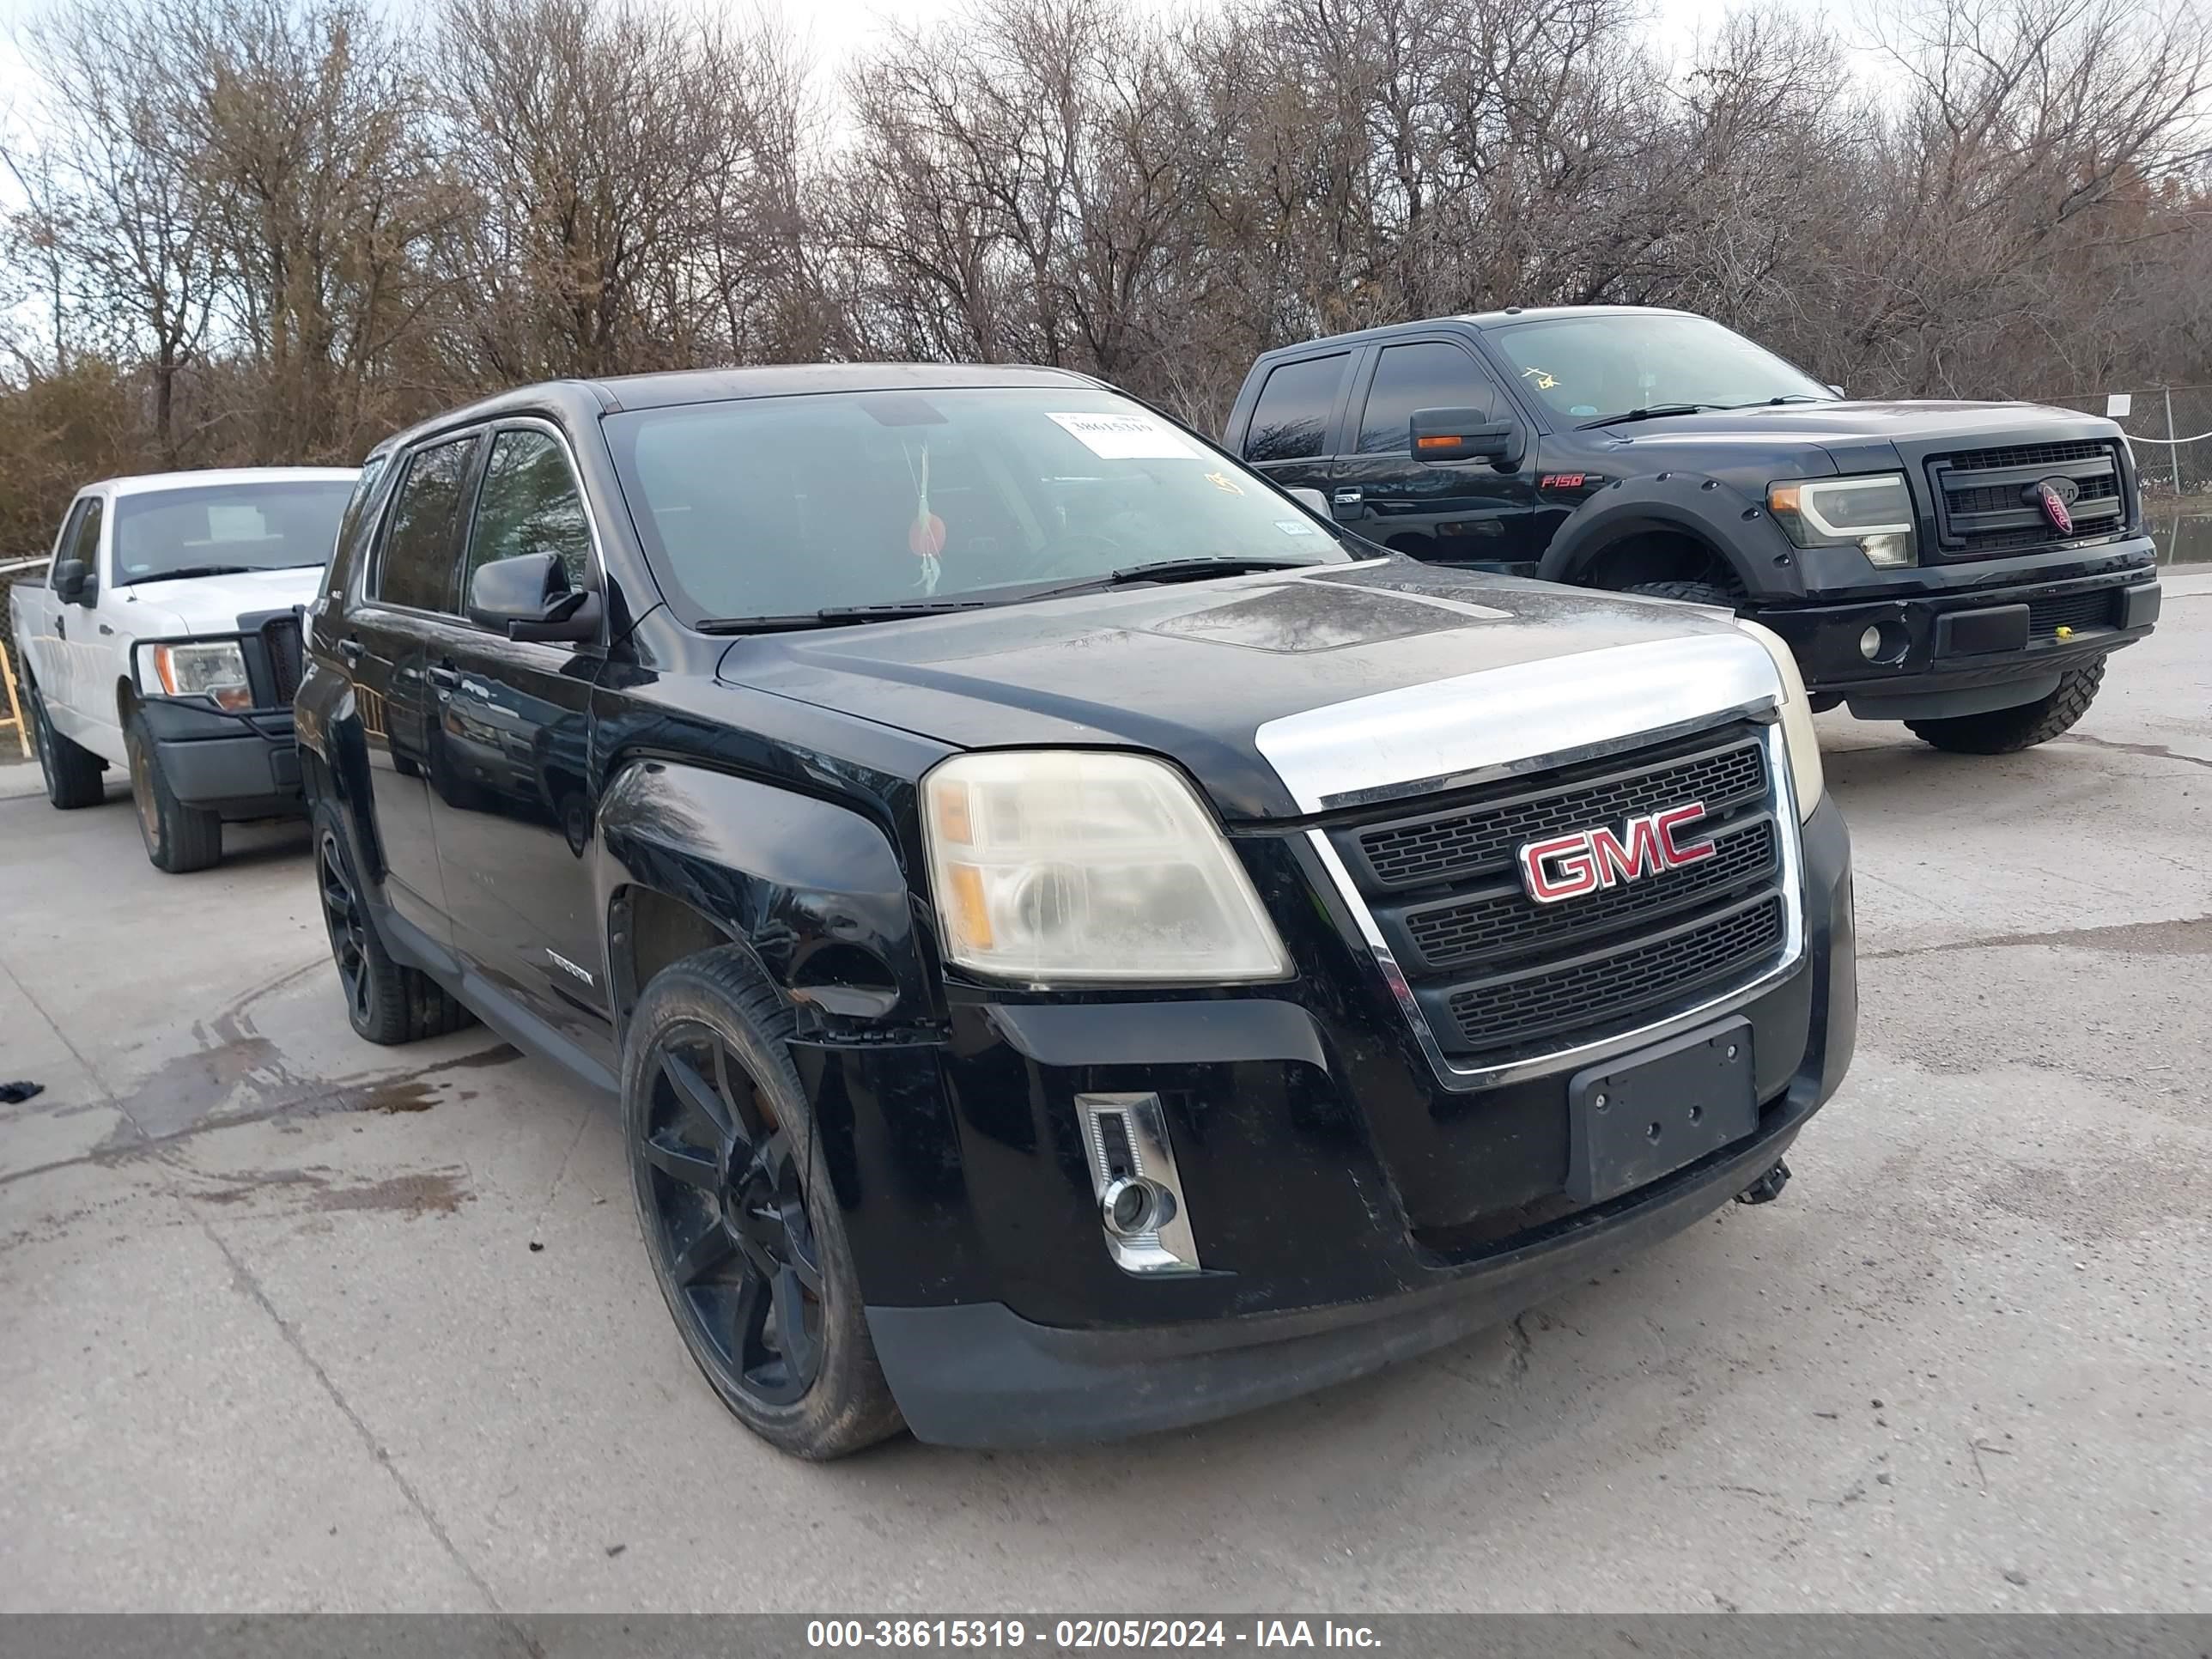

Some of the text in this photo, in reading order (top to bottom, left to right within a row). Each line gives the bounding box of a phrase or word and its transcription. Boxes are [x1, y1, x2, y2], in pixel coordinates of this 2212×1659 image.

[1541, 472, 1586, 488] F-150
[2046, 495, 2069, 526] Ford
[1519, 800, 1717, 904] GMC
